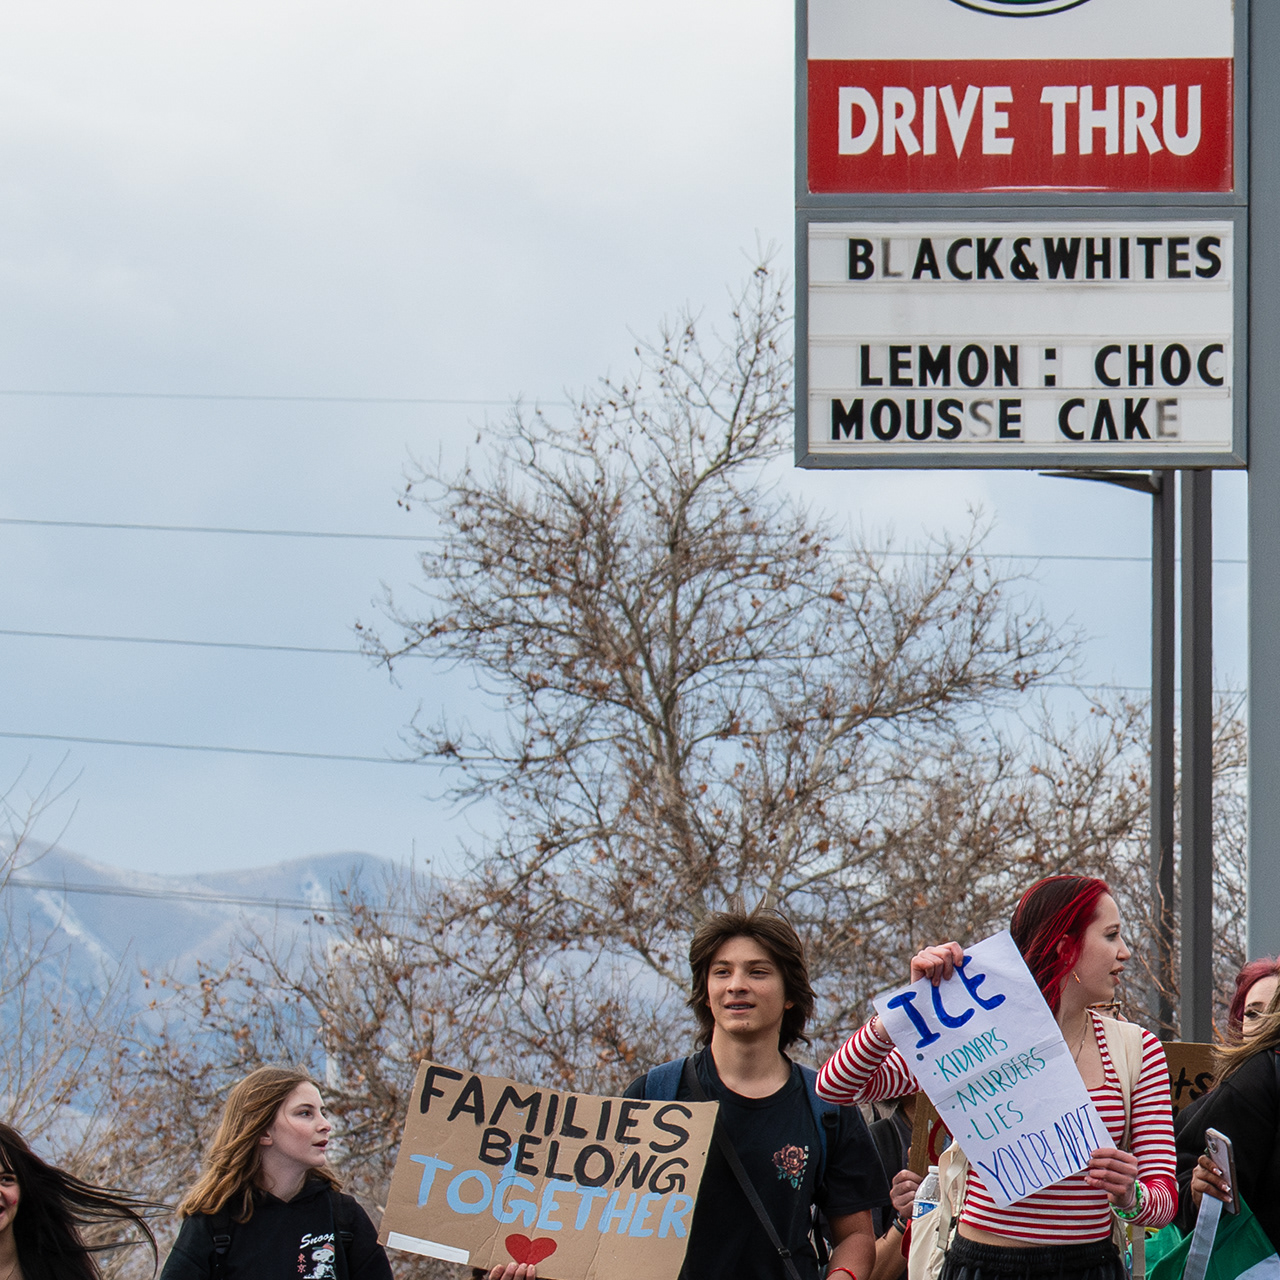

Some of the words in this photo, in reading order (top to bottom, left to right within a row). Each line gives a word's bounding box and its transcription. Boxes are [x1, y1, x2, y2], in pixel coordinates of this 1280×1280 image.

[838, 84, 1014, 159] DRIVE
[1040, 84, 1201, 156] THRU
[848, 236, 1222, 281] BLACK&WHITES
[860, 344, 1018, 386] LEMON
[1095, 343, 1224, 386] CHOC
[831, 398, 1022, 441] MOUSSE
[1058, 398, 1179, 440] CAKE
[886, 955, 1006, 1049] ICE
[935, 1026, 1008, 1082] KIDNAPS
[956, 1046, 1046, 1112] MURDERS
[420, 1065, 692, 1154] FAMILIES
[971, 1100, 1024, 1141] LIES
[478, 1127, 689, 1194] BELONG
[977, 1130, 1065, 1201] YOU'RE
[409, 1153, 694, 1238] TOGETHER
[299, 1233, 335, 1249] Snoop
